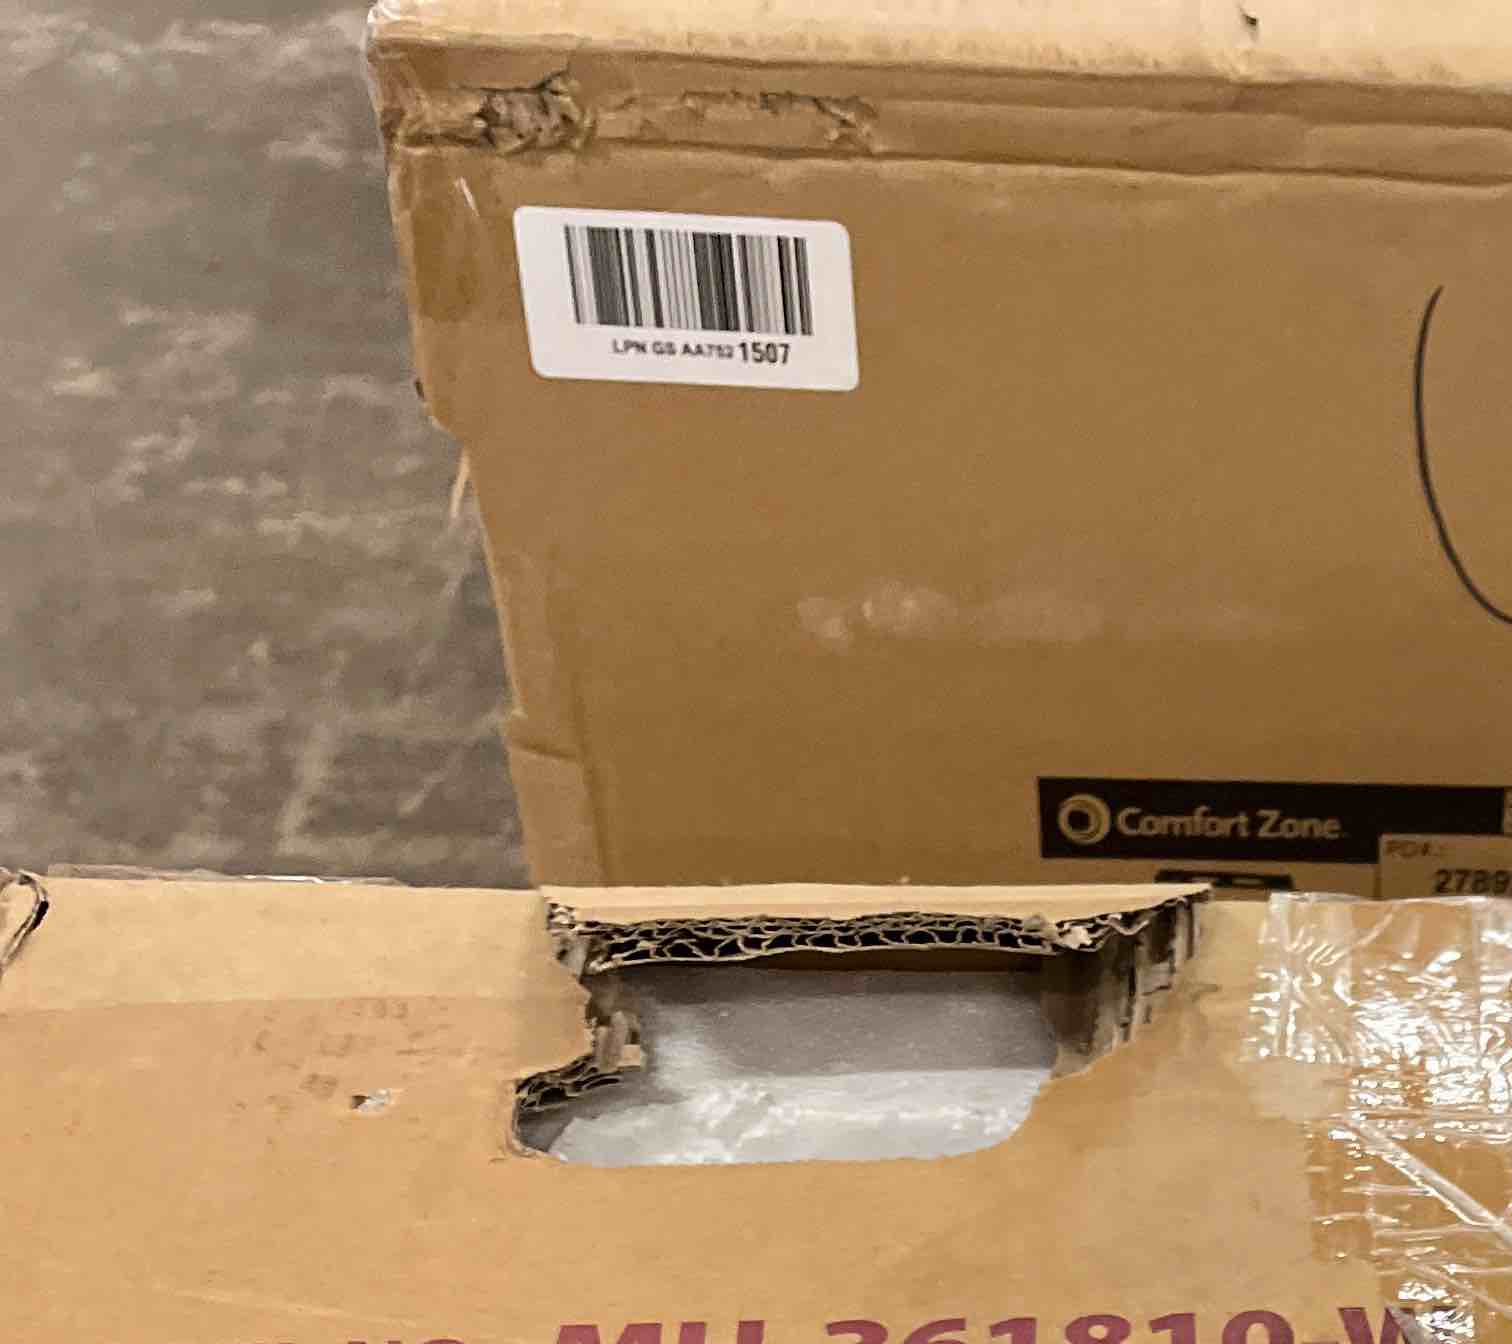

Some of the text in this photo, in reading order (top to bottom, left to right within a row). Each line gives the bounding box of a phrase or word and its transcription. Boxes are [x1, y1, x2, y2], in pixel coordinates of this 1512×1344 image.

[739, 342, 791, 364] 1507
[1117, 807, 1342, 840] Comfort Zone
